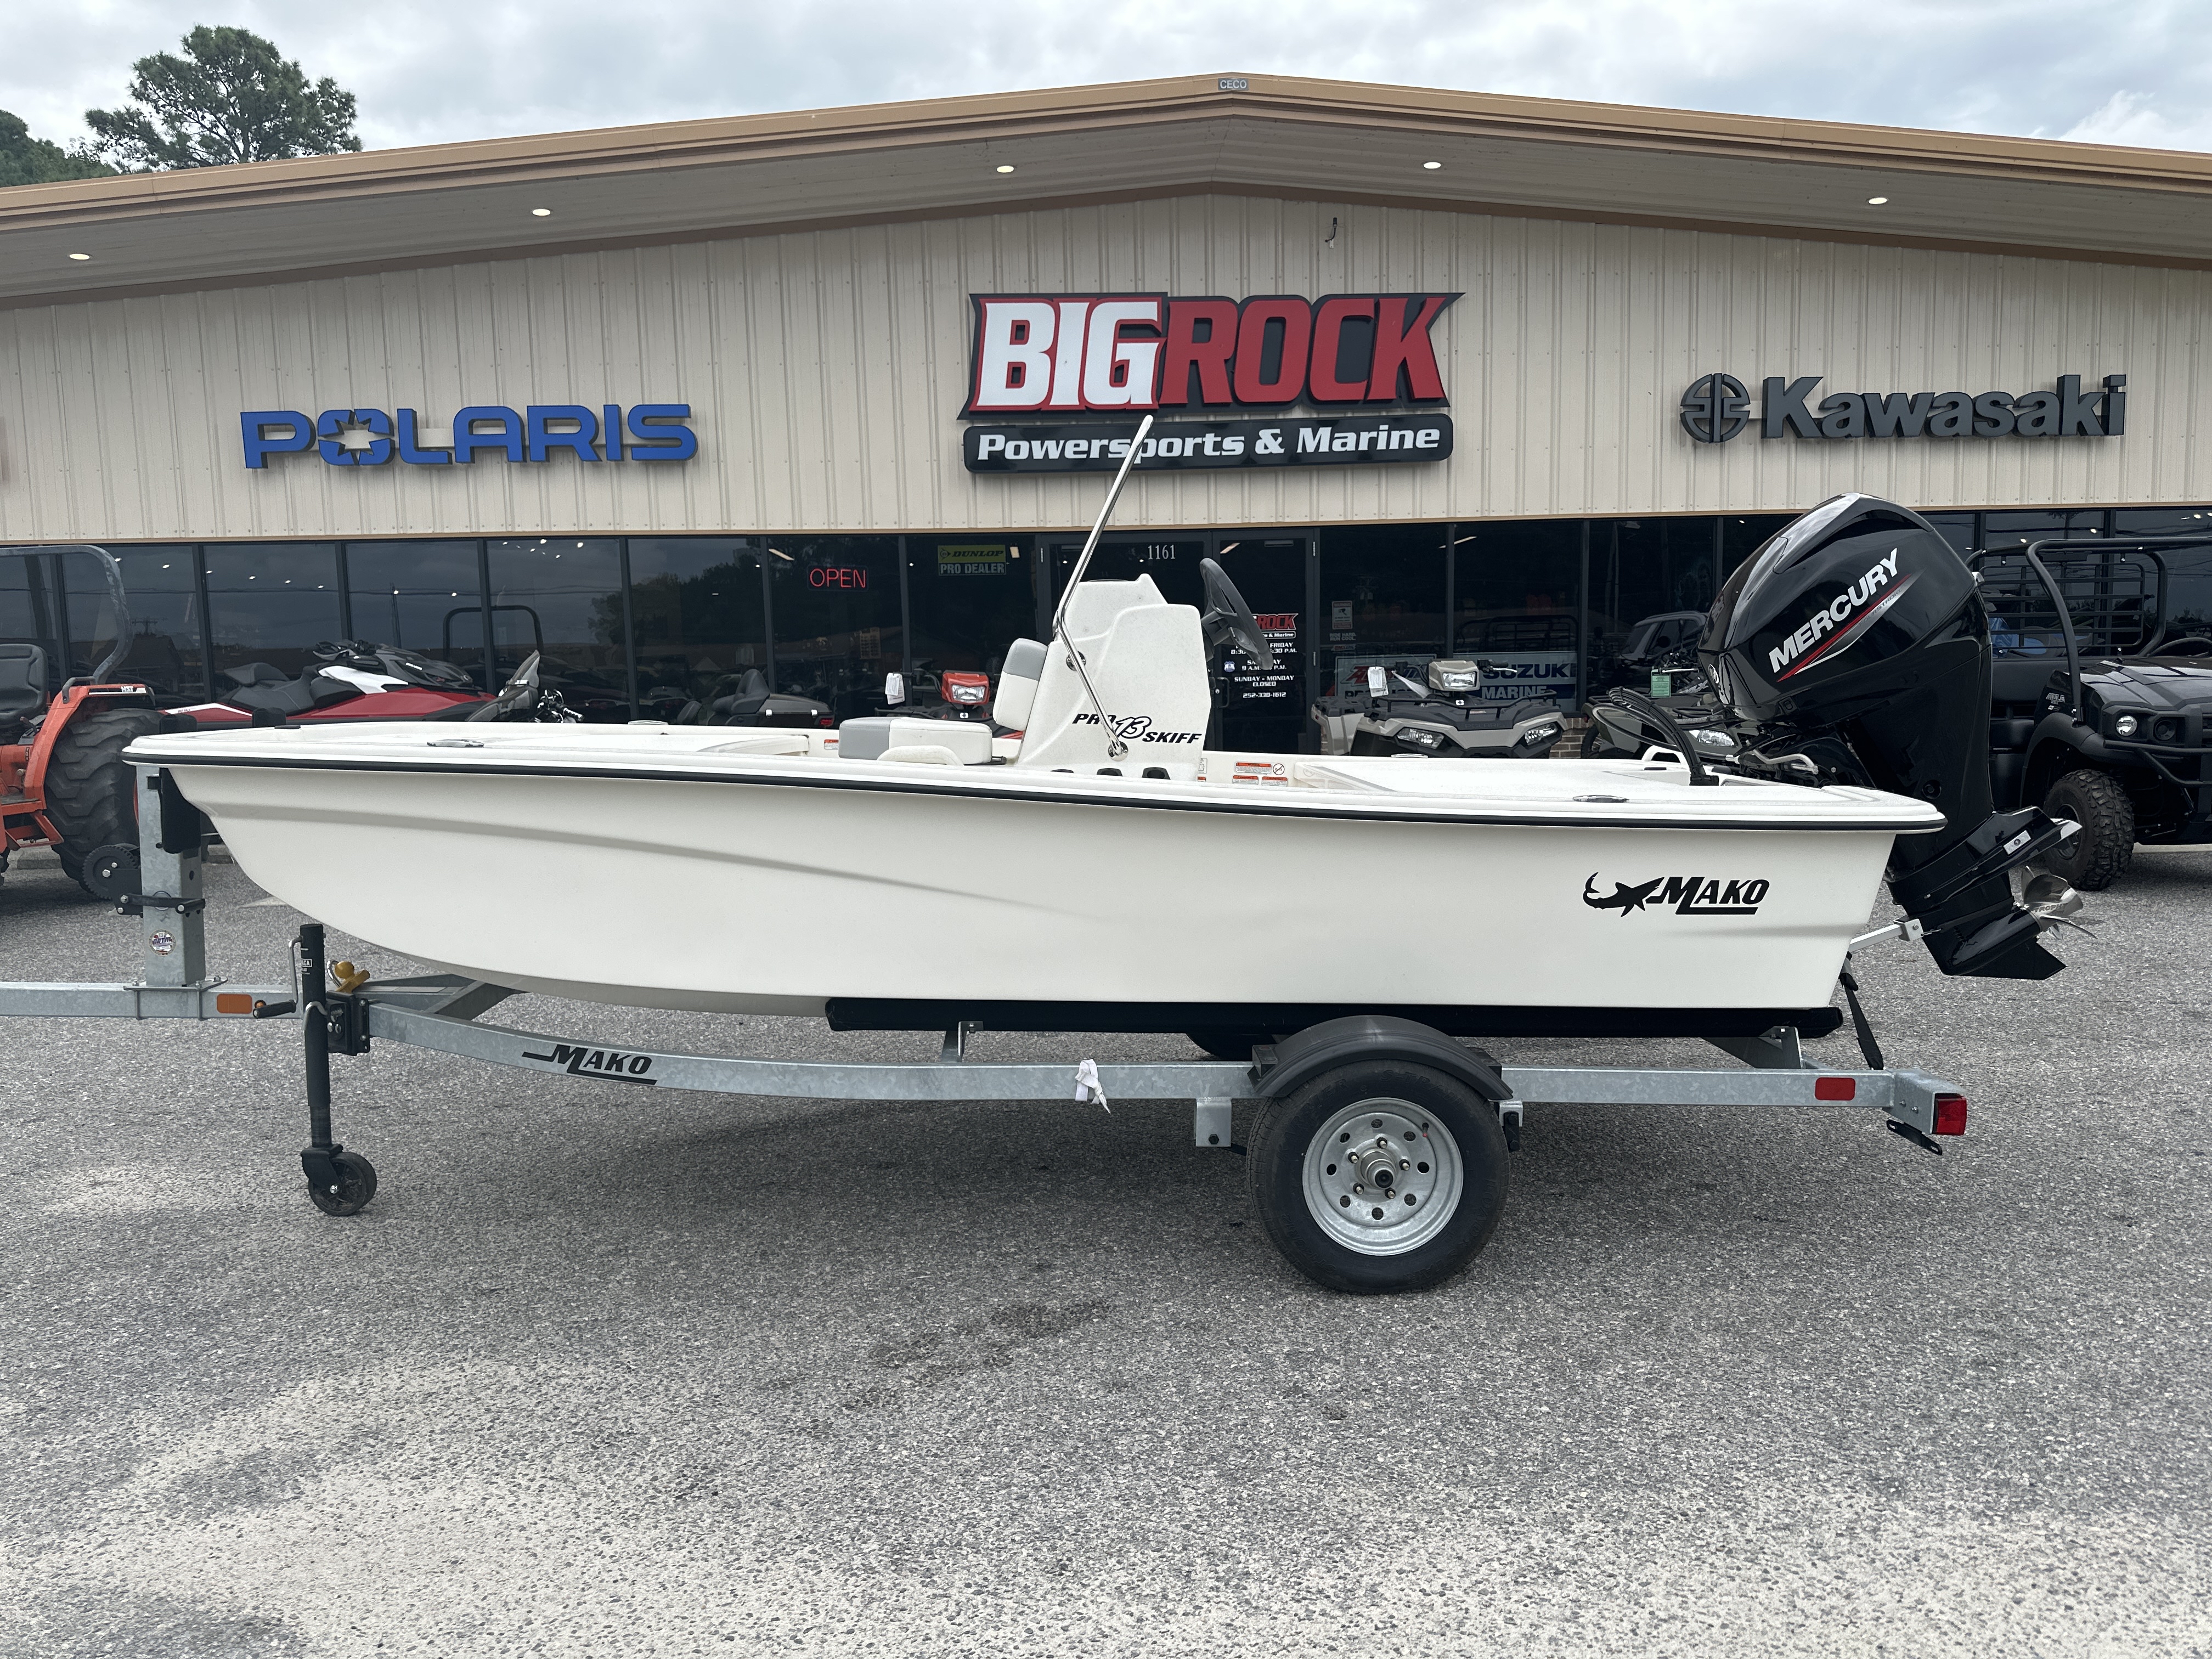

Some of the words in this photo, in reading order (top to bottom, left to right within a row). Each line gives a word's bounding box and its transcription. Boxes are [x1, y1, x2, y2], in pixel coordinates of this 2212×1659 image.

[1220, 80, 1247, 89] CECO
[1761, 374, 2127, 439] Kawasaki
[240, 403, 698, 468] POLARIS
[978, 429, 1244, 464] Powersports
[1255, 428, 1285, 455] &
[1296, 425, 1440, 453] Marine
[940, 563, 962, 574] PRO
[964, 562, 1005, 574] DEALER
[1147, 544, 1176, 560] 1161
[809, 568, 866, 589] OPEN
[1769, 548, 1900, 674] MERCURY
[1142, 732, 1203, 744] SKIFF
[1646, 876, 1770, 915] MAKO
[522, 1044, 657, 1085] MAKO
